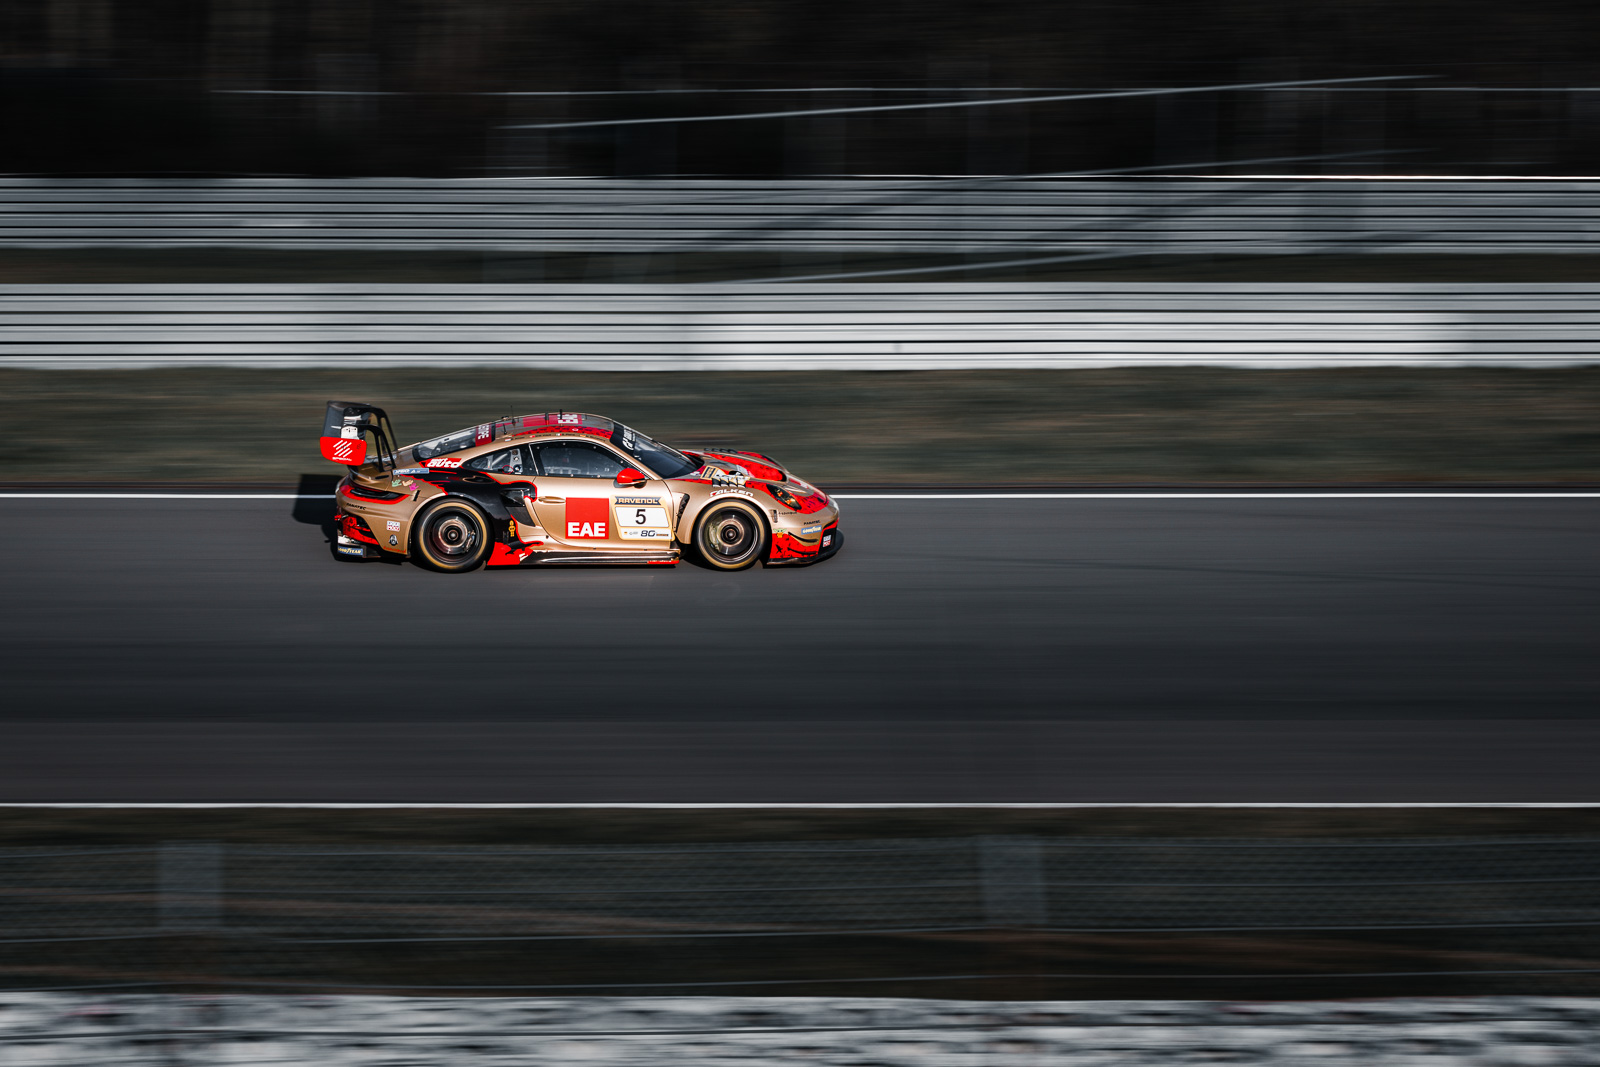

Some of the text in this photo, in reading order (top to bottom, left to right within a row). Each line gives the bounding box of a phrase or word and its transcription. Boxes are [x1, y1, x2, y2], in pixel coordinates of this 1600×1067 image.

[346, 502, 366, 510] FANATEC
[635, 508, 646, 525] 5
[567, 522, 606, 537] EAE
